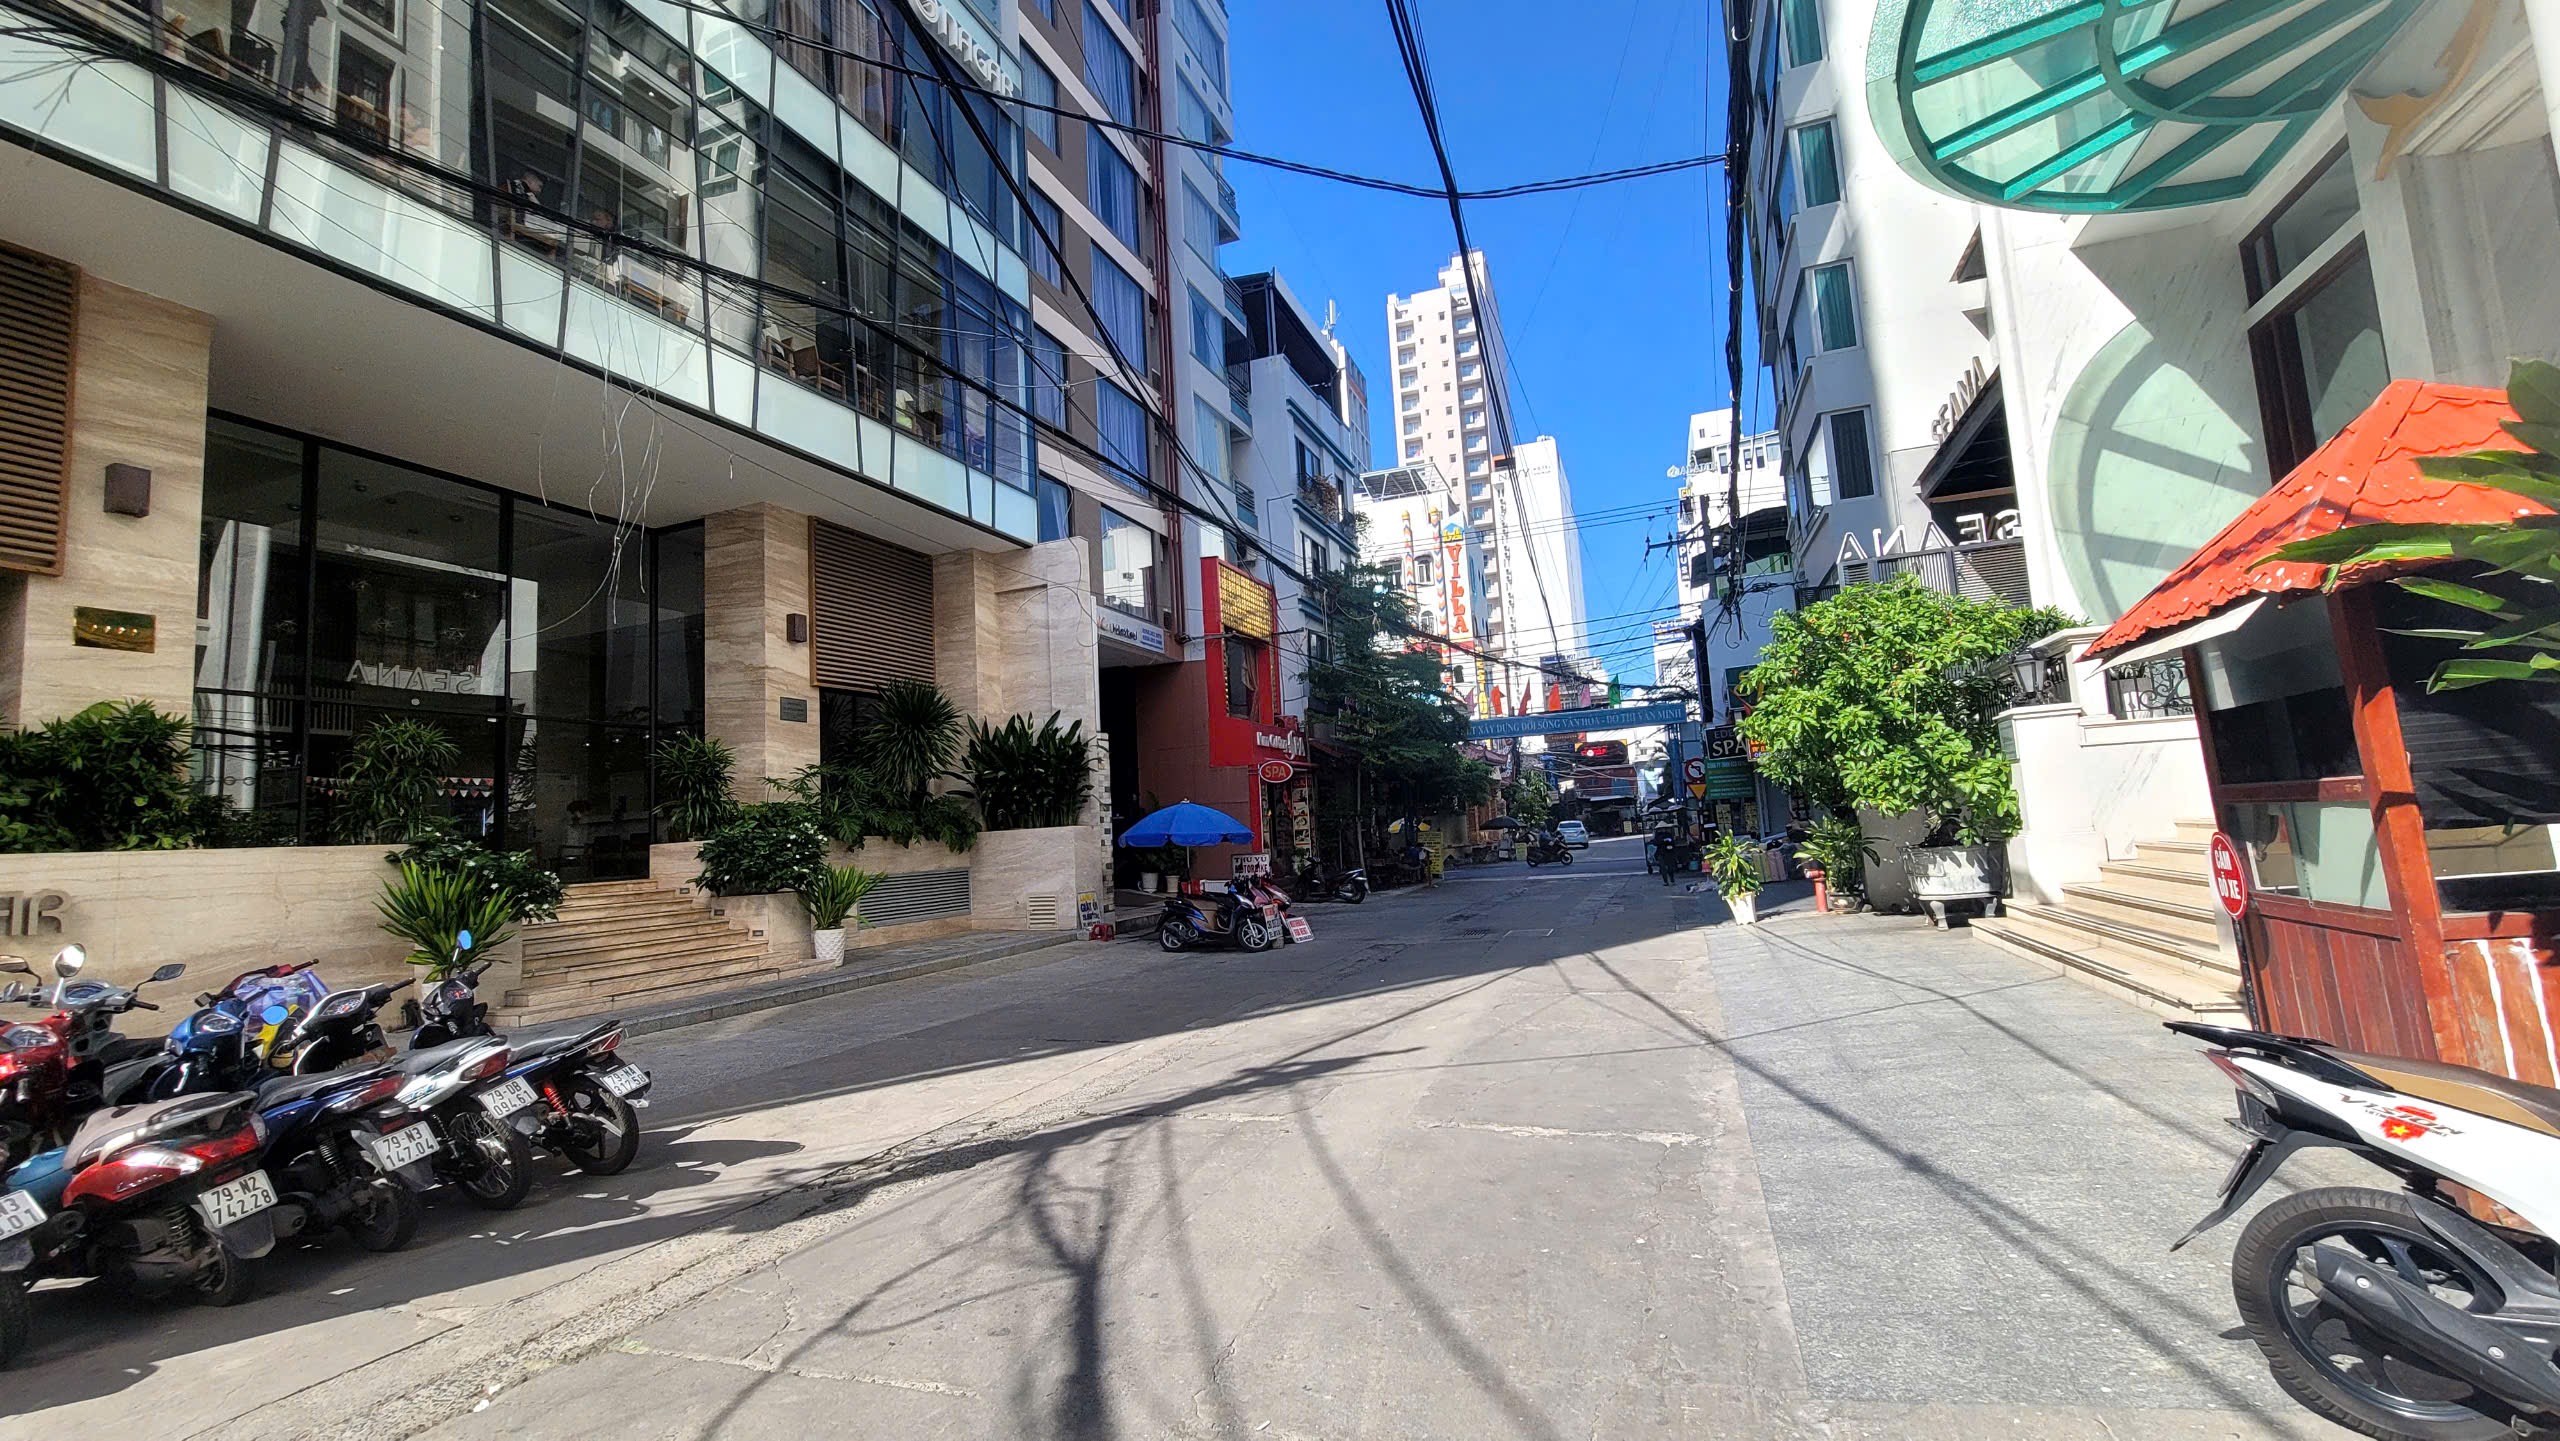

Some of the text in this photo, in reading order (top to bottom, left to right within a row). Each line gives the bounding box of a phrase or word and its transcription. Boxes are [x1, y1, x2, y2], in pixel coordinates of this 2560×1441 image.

[1446, 543, 1469, 634] VILLA
[1712, 739, 1749, 757] SPA
[1265, 766, 1286, 778] SPA
[2227, 879, 2241, 900] XE
[487, 1081, 522, 1104] 79-DB
[493, 1090, 533, 1116] 094.61
[382, 1127, 422, 1153] 79-N3
[386, 1138, 435, 1167] 147.04
[211, 1176, 262, 1207] 79-N2
[212, 1189, 272, 1224] 742.28
